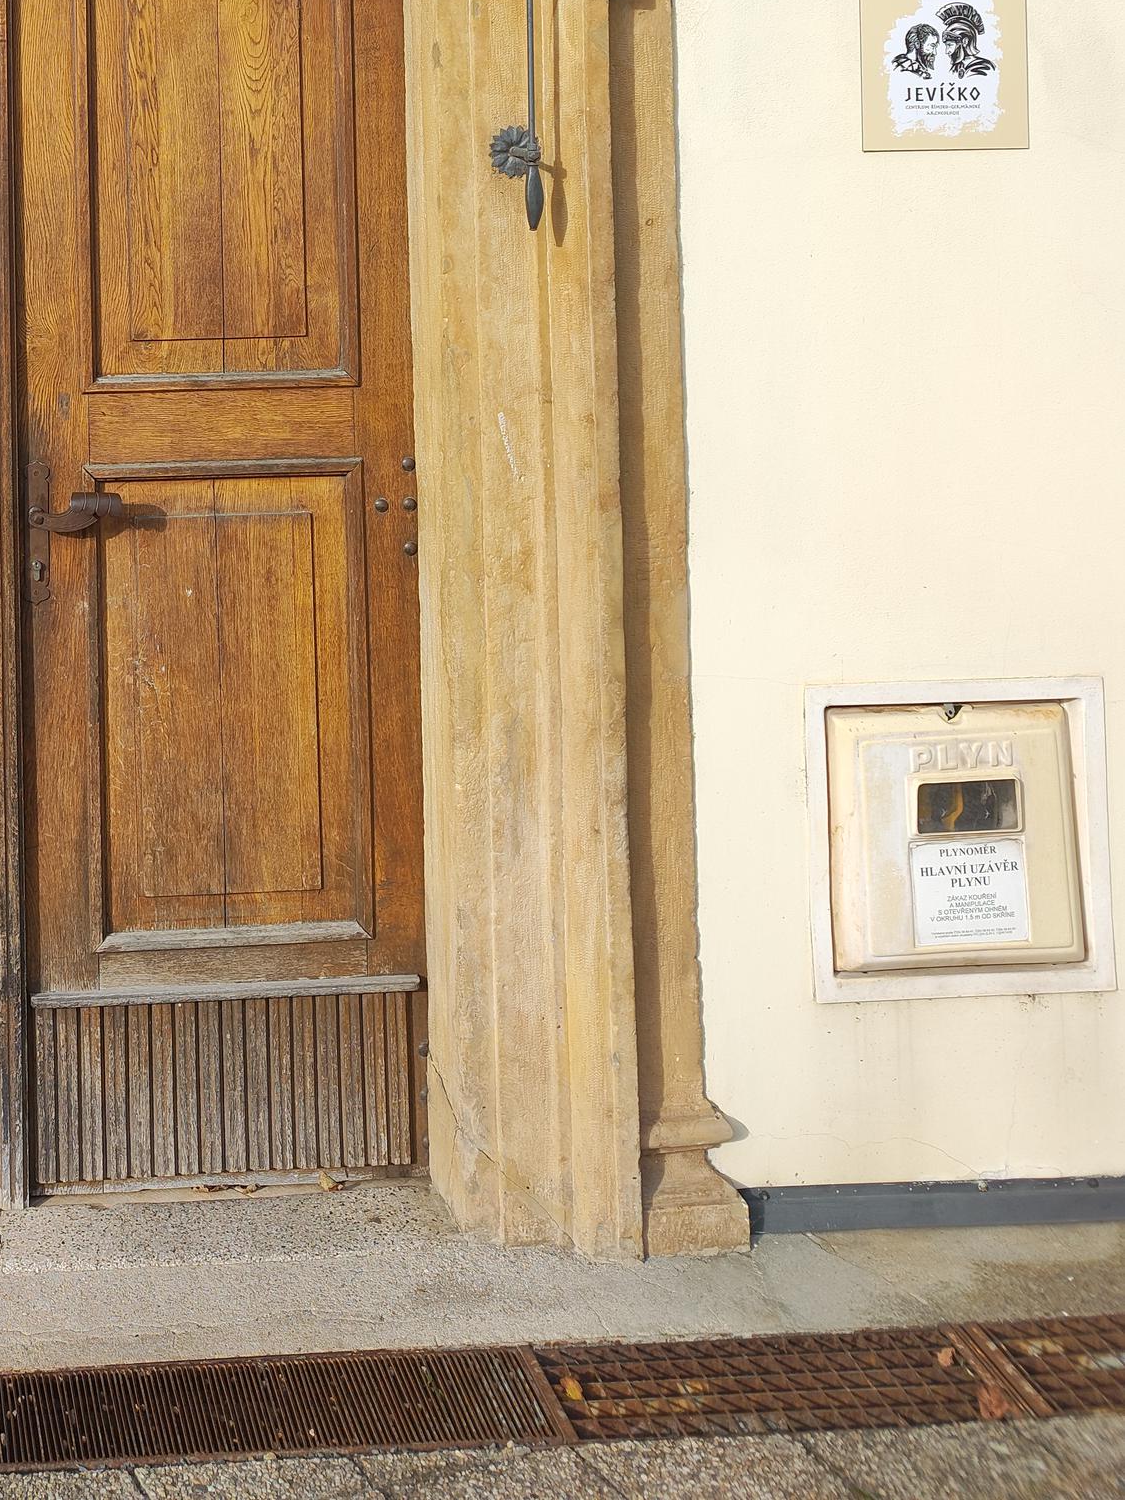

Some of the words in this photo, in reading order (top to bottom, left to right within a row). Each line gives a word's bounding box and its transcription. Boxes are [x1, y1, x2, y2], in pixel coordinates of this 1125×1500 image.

[905, 82, 981, 102] JEVÍČKO
[910, 740, 1014, 773] PLYN
[939, 844, 997, 858] PLYNOMĚR
[920, 862, 967, 877] HLAVNÍ
[970, 859, 1019, 874] UZÁVĚR
[951, 876, 991, 888] PLYNU
[947, 894, 967, 902] ZÁKAZ
[968, 892, 997, 900] KOUŘENÍ
[955, 900, 995, 908] MANIPULACE
[944, 907, 983, 915] OTEVŘENÝM
